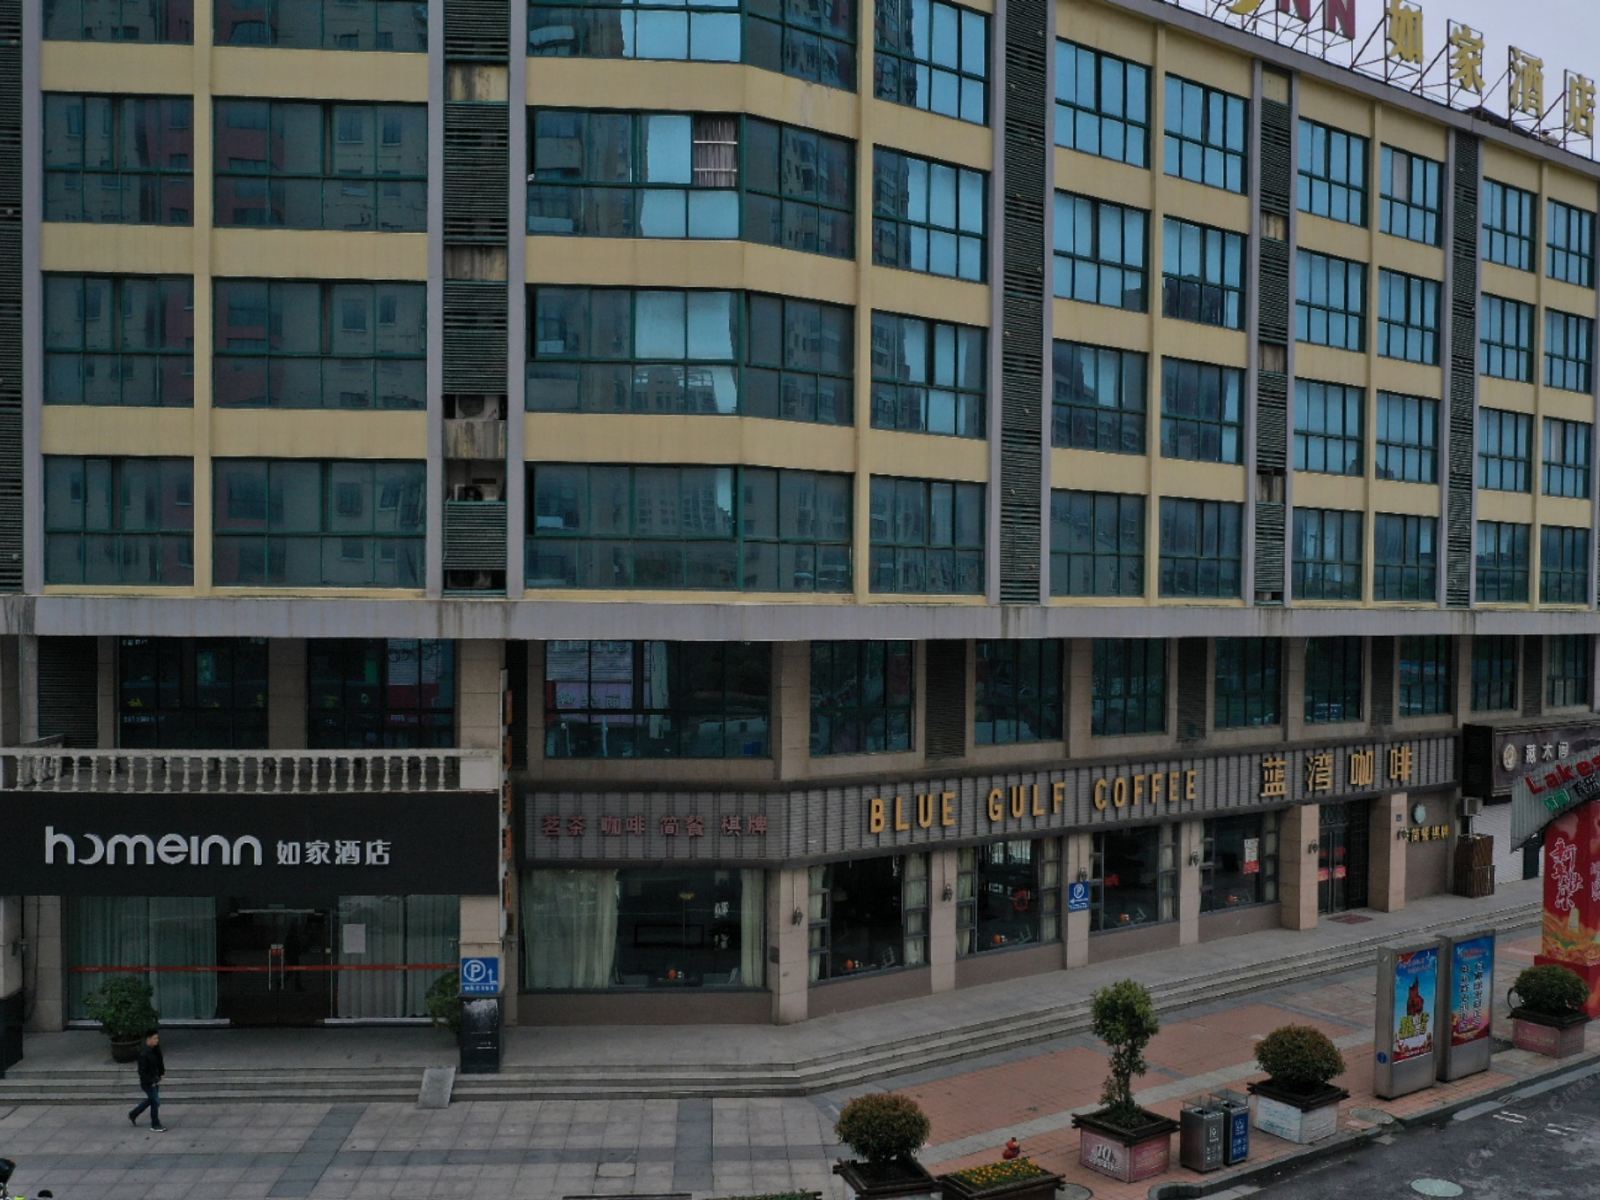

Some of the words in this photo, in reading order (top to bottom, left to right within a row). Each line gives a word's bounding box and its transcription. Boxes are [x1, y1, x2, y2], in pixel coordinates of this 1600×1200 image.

[1388, 0, 1596, 139] 如家酒店
[1261, 745, 1414, 798] 蓝湾咖啡
[542, 814, 586, 837] 茗茶
[601, 815, 646, 837] 咖啡
[660, 815, 706, 837] 简餐
[721, 814, 769, 837] 棋牌
[869, 790, 956, 834] BLUE
[987, 781, 1067, 823] GULF
[1094, 768, 1198, 810] COFFEE
[276, 838, 392, 866] 如家酒店
